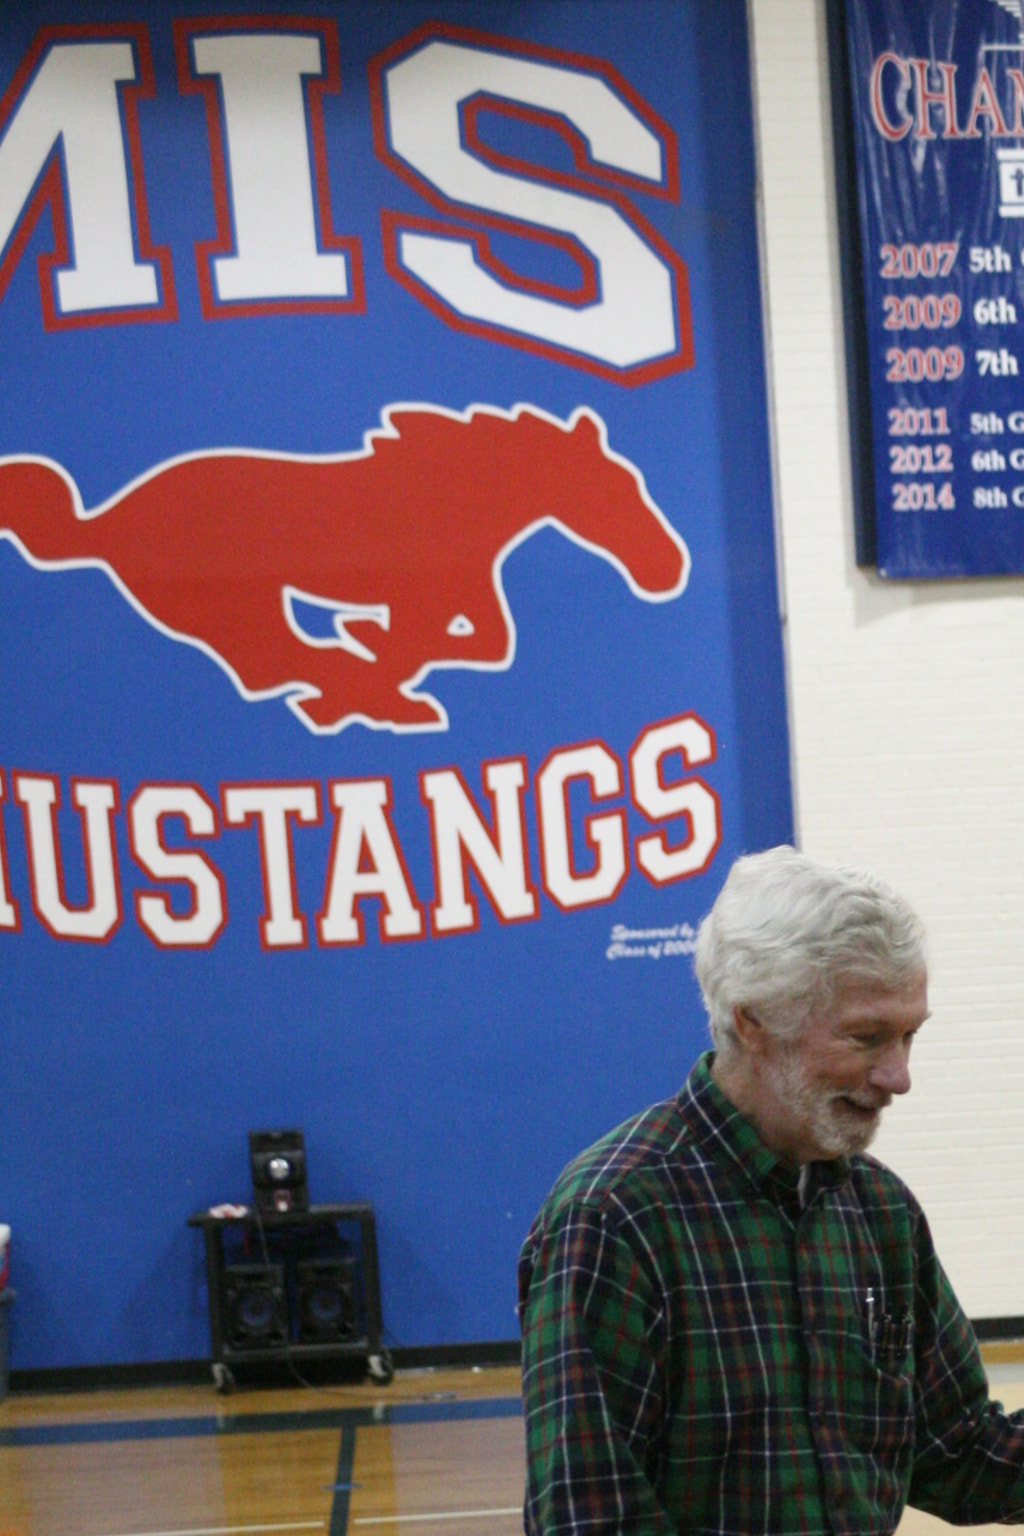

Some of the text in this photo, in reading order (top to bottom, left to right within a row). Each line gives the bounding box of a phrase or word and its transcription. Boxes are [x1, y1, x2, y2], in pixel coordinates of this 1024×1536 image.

[880, 243, 958, 278] 2007
[969, 246, 1011, 273] 5th
[883, 294, 961, 329] 2009
[974, 297, 1016, 325] 6th
[886, 346, 964, 382] 2009
[976, 349, 1018, 376] 7th
[888, 407, 949, 435] 2011
[970, 410, 1004, 435] 5th
[889, 445, 953, 473] 2012
[971, 449, 1005, 472] 6th
[892, 482, 955, 511] 2014
[973, 485, 1007, 509] 8th
[0, 710, 722, 952] USTANGS
